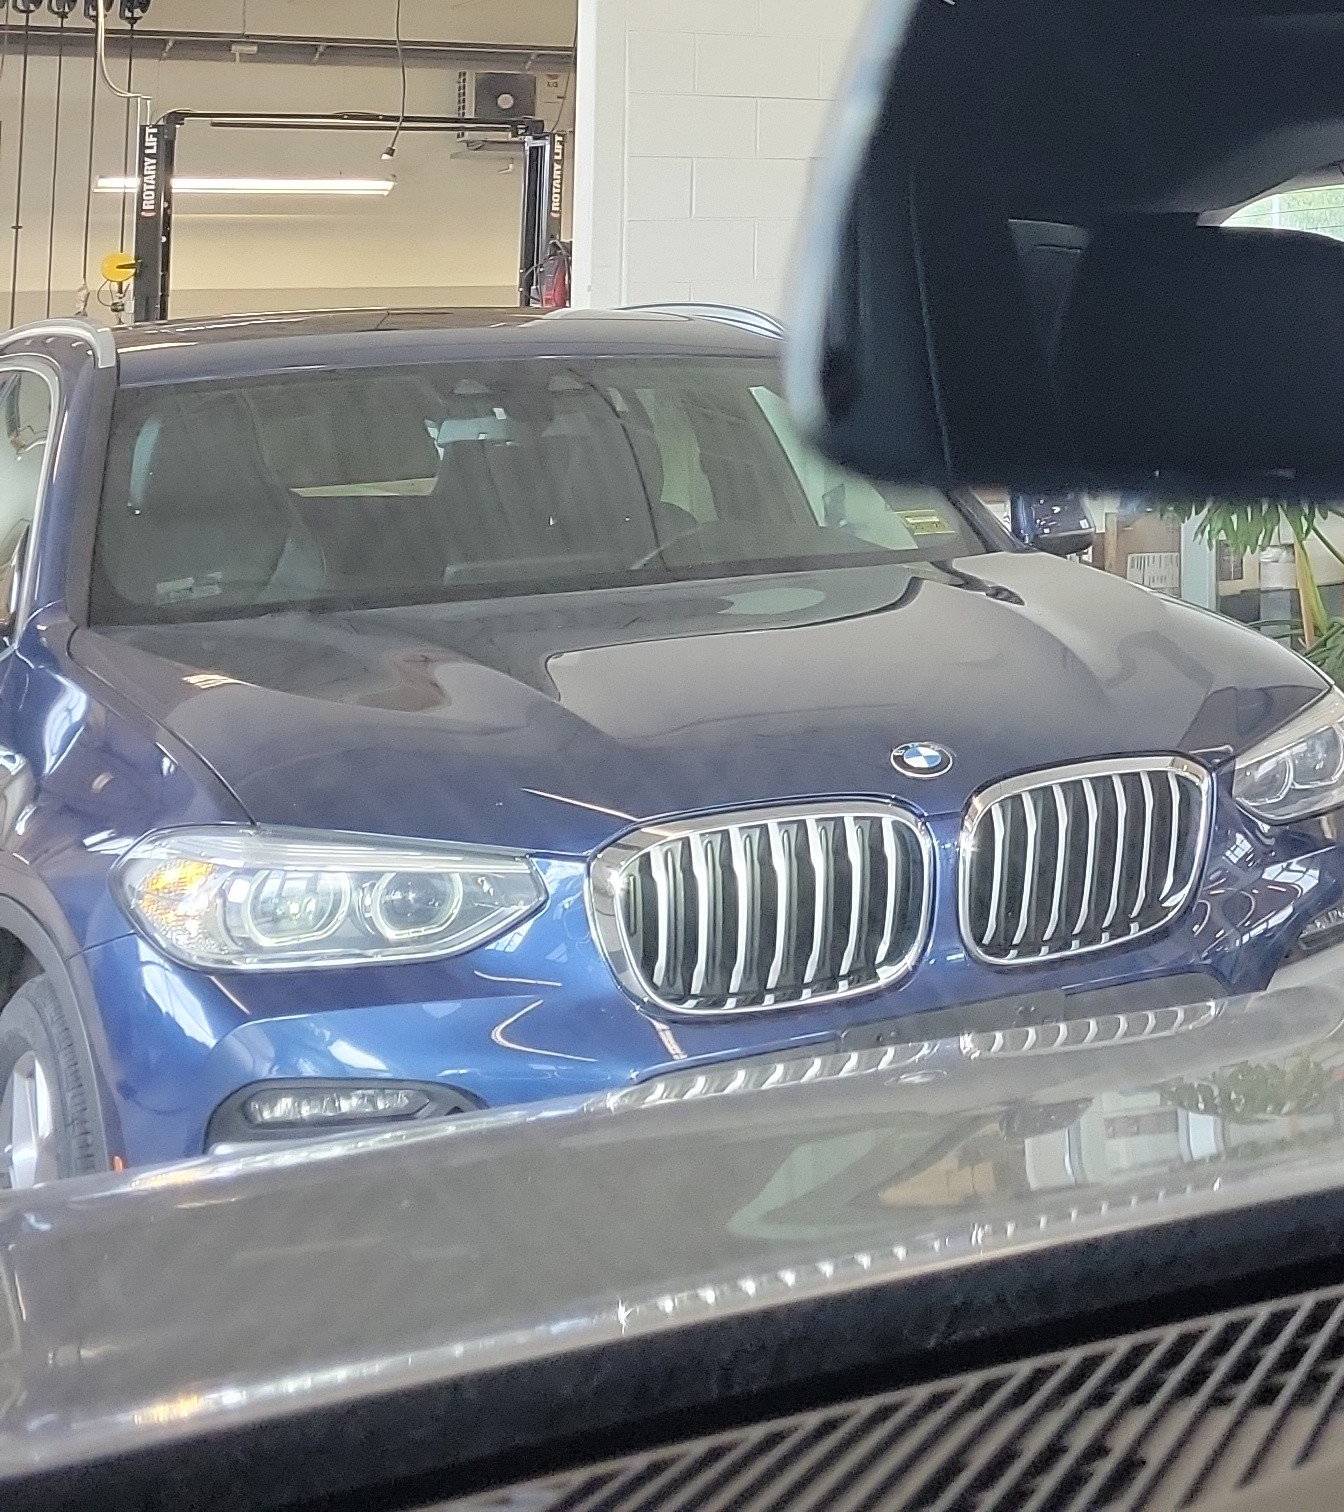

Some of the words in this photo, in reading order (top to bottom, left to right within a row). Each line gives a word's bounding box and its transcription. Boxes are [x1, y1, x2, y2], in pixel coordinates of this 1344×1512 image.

[144, 126, 158, 154] LIFT
[553, 134, 564, 160] LIFT
[142, 156, 157, 210] ROTARY
[551, 163, 562, 211] ROTARY
